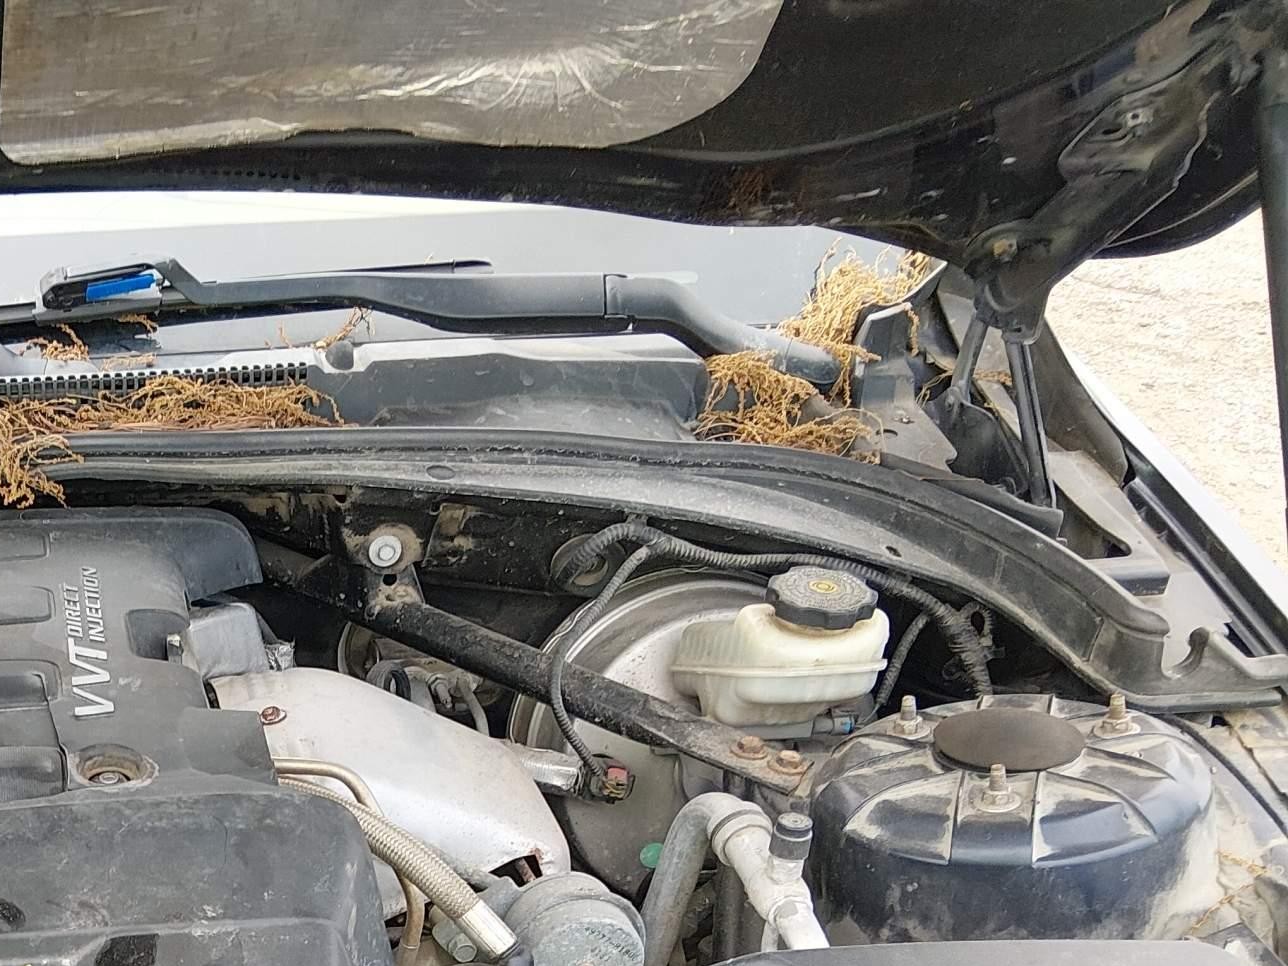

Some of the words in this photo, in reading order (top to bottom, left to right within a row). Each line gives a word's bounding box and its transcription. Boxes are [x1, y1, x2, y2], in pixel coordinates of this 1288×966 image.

[63, 582, 84, 639] DIRECT
[81, 566, 106, 642] INJECTION
[67, 637, 115, 717] VVT
